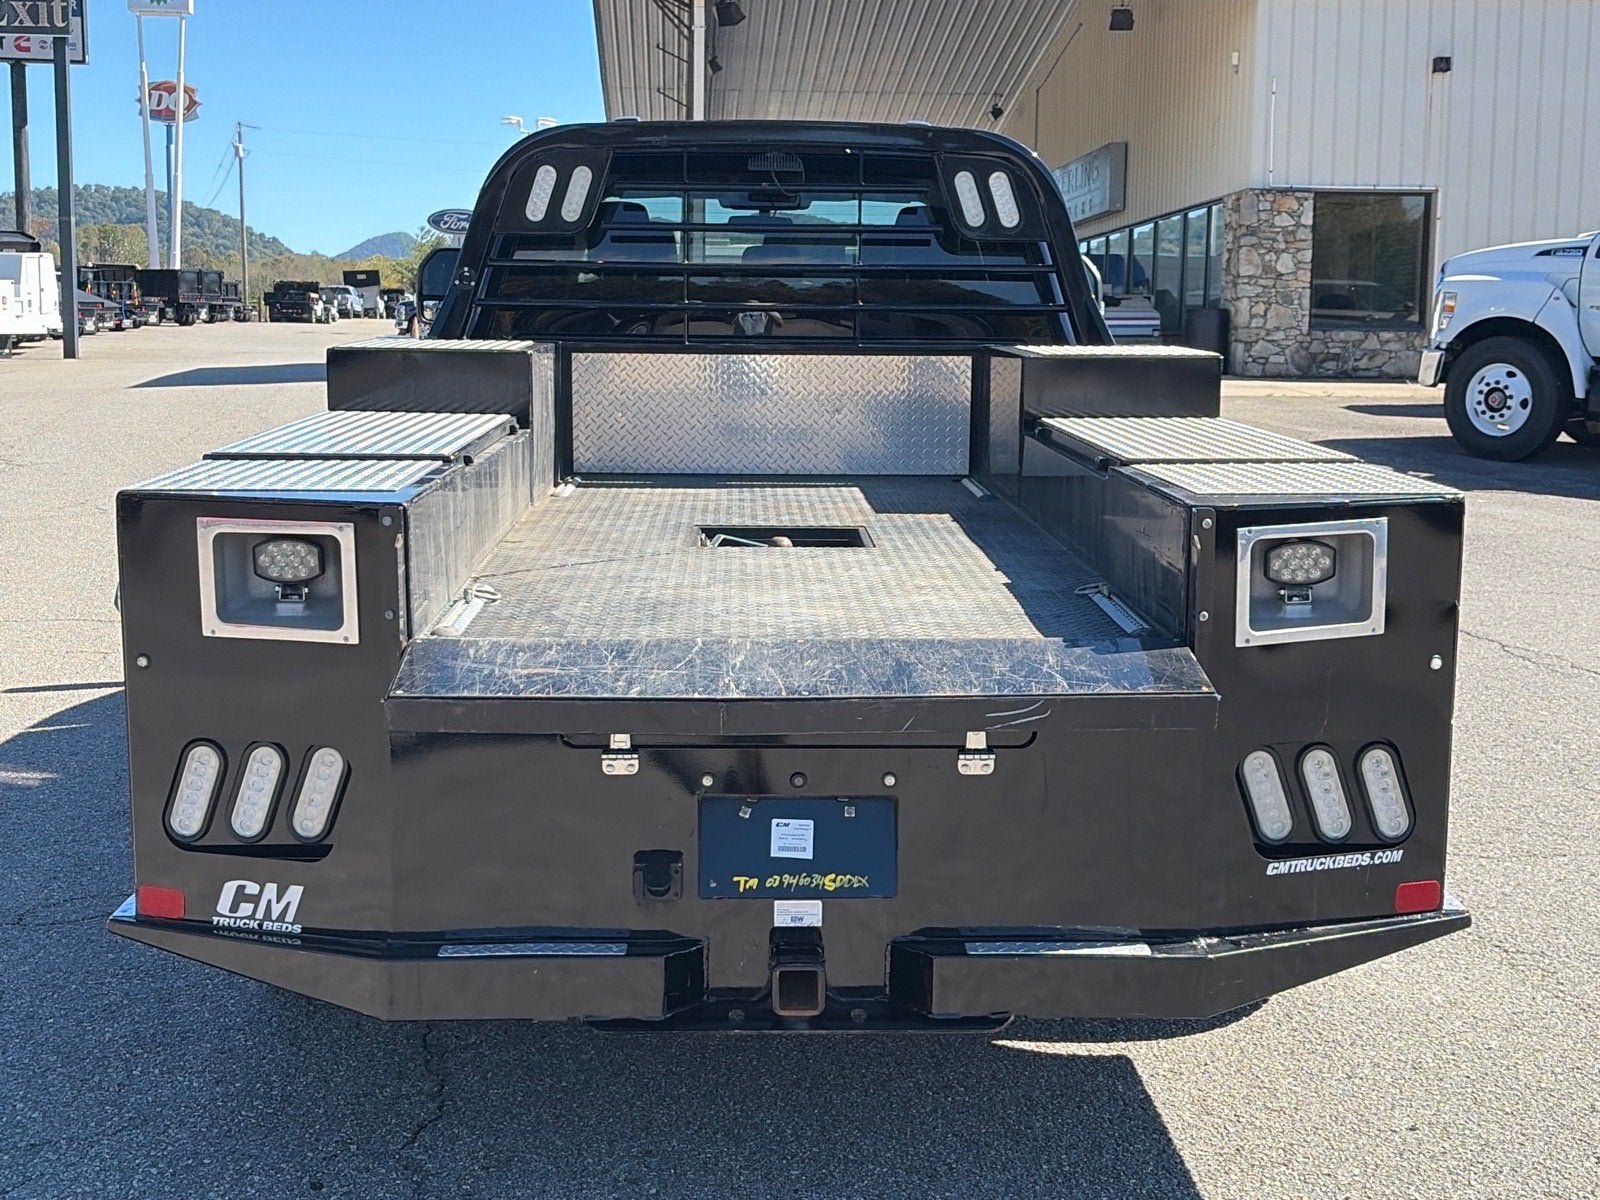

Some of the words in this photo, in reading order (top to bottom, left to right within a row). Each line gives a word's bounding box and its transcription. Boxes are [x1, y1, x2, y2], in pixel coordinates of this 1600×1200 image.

[0, 0, 68, 27] xit
[1056, 160, 1100, 194] ERLING
[1266, 849, 1403, 876] CMTRUCKBEDS.COM
[216, 879, 304, 922] CM
[212, 916, 260, 930] TRUCK
[262, 920, 302, 934] BEDS
